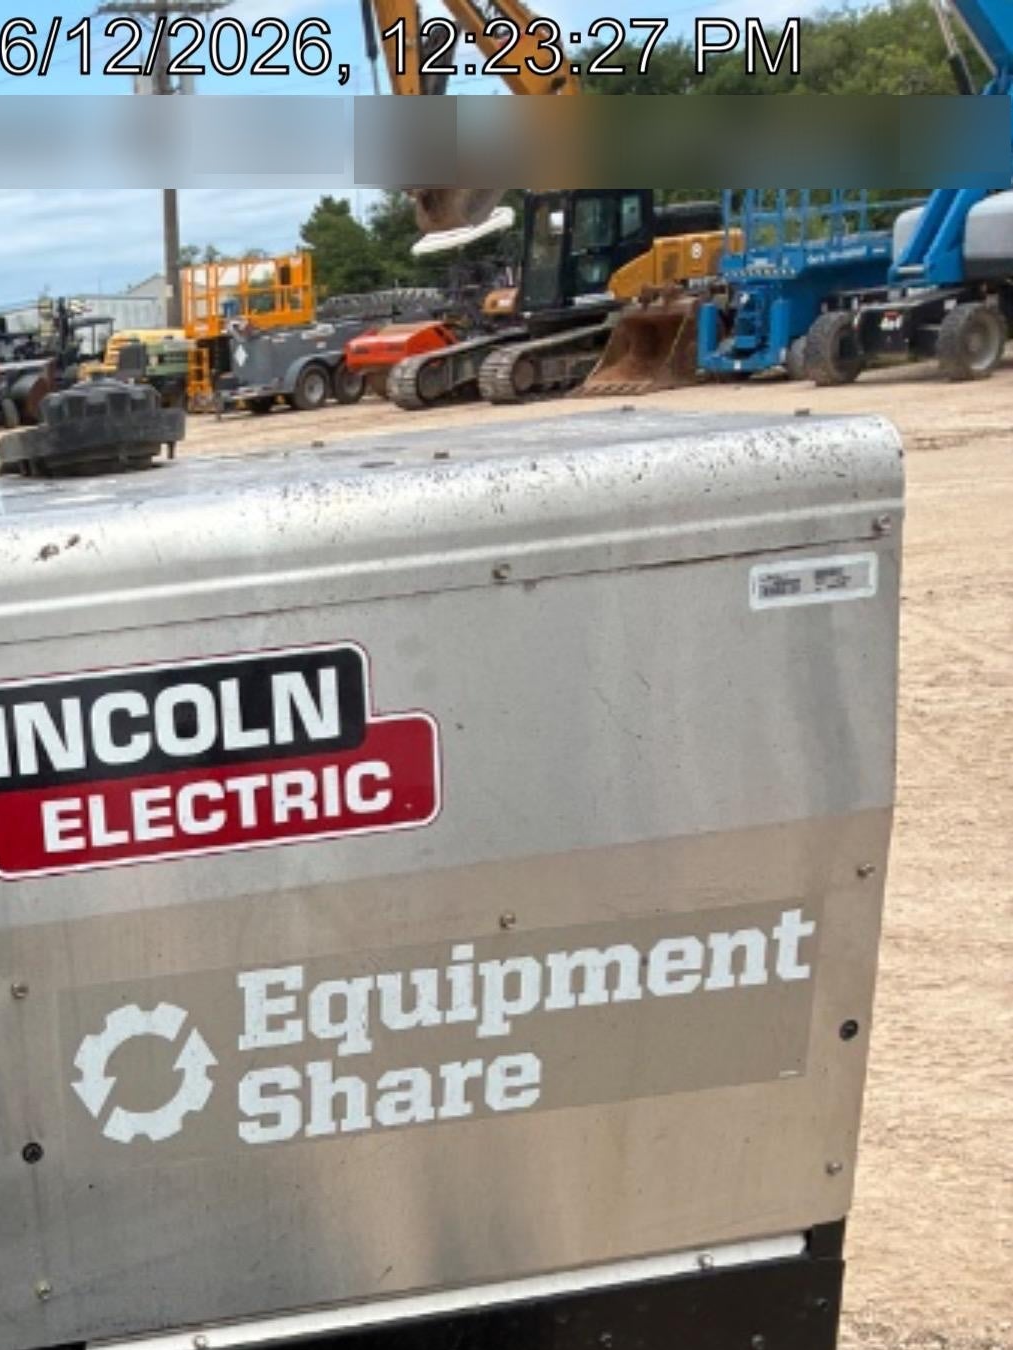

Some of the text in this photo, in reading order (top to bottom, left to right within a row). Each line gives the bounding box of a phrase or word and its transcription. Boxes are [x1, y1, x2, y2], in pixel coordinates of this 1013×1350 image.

[40, 760, 392, 854] ELECTRIC
[237, 908, 816, 1057] Equipment
[237, 1052, 543, 1144] Share
